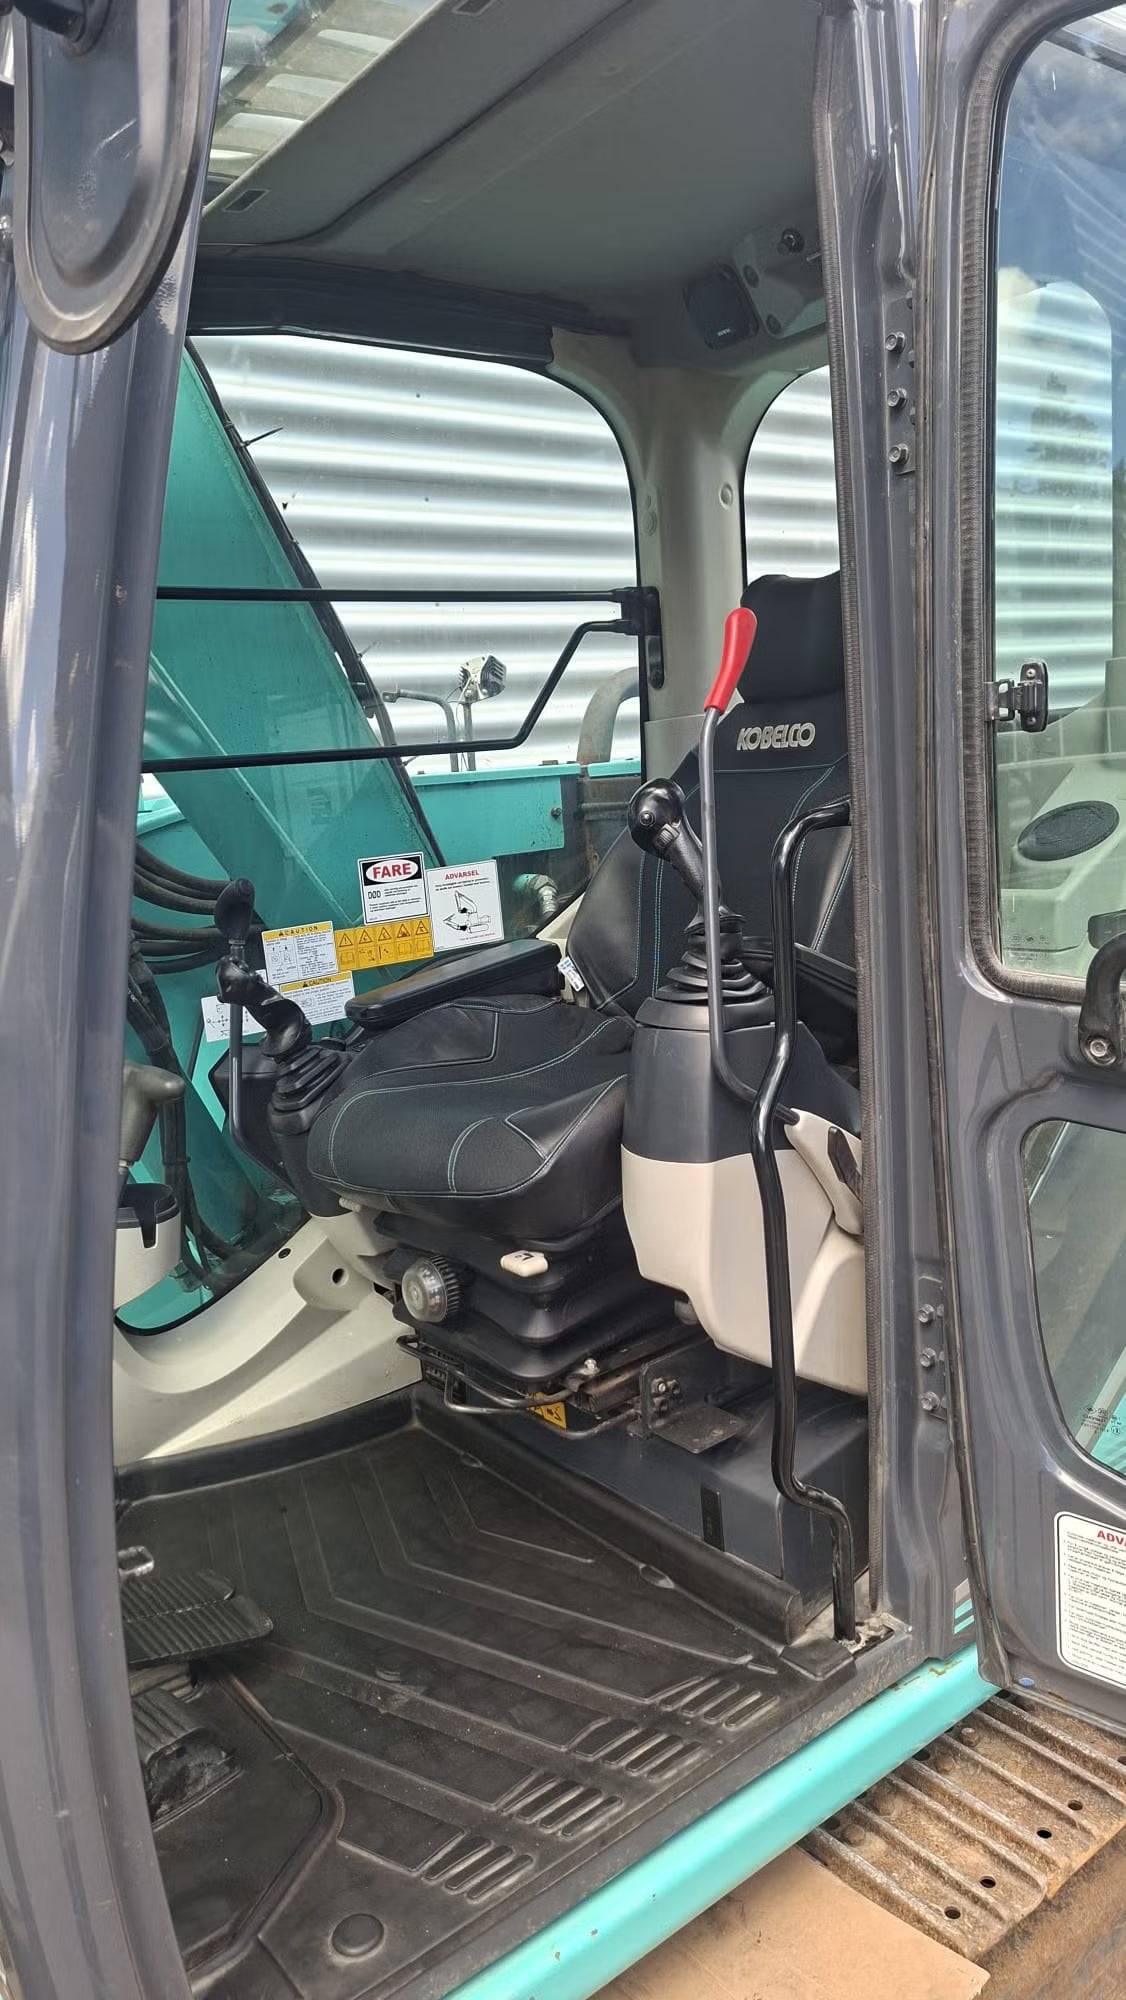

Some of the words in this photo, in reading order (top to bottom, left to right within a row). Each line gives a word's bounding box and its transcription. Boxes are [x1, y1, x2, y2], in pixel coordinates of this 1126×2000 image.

[736, 722, 816, 751] KOBELCO
[372, 863, 412, 880] FARE
[445, 869, 480, 881] ADVARSEL
[285, 925, 318, 936] CAUTION
[308, 977, 332, 987] CAUTION
[1097, 1530, 1126, 1547] ADV
